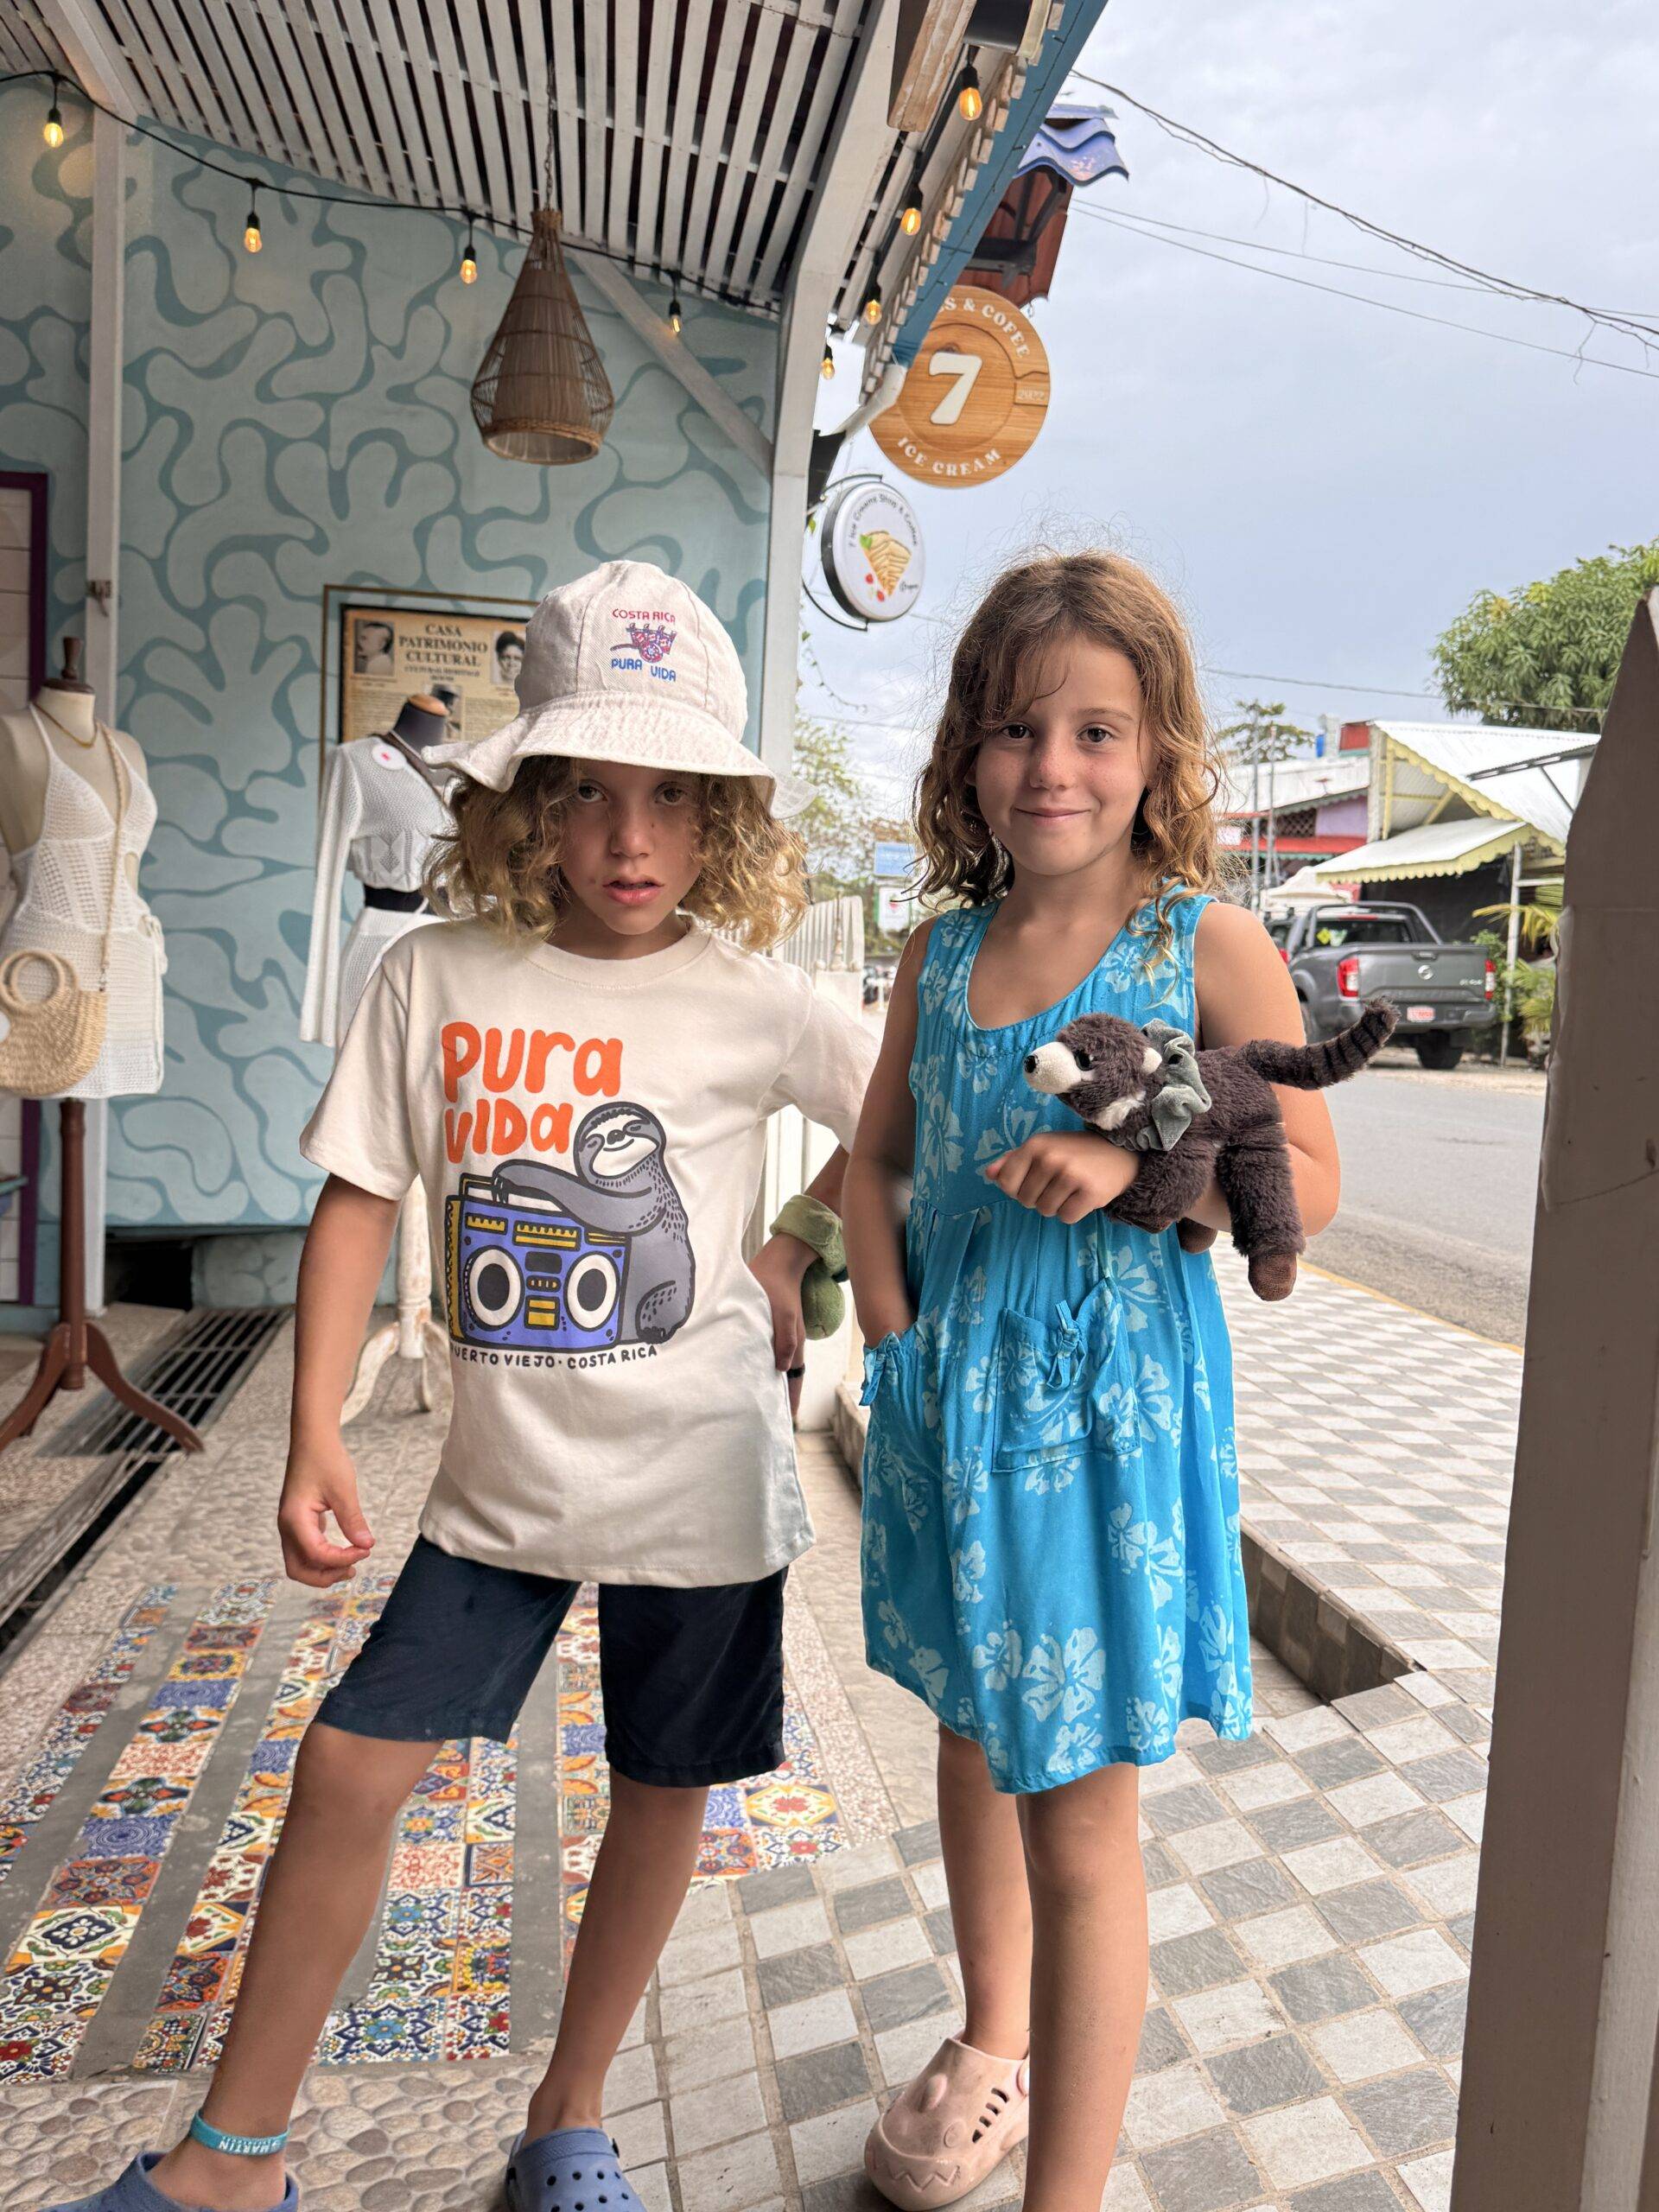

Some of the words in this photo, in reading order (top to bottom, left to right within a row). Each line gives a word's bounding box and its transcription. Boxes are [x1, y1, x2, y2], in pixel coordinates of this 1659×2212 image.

[963, 298, 976, 311] &
[981, 304, 1030, 359] COFEE
[929, 352, 983, 425] 7
[898, 436, 929, 467] ICE
[931, 448, 1001, 476] CREAM
[612, 608, 650, 620] COSTA
[652, 611, 677, 623] RICA
[425, 624, 462, 638] CASA
[398, 635, 489, 653] PATRIMONIO
[405, 651, 481, 666] CULTURAL
[611, 658, 643, 671] PURA
[650, 665, 677, 683] VIDA
[504, 1353, 556, 1369] VIEJO
[567, 1352, 617, 1370] COSTA
[621, 1345, 658, 1363] RICA
[219, 2140, 270, 2154] MARTIN
